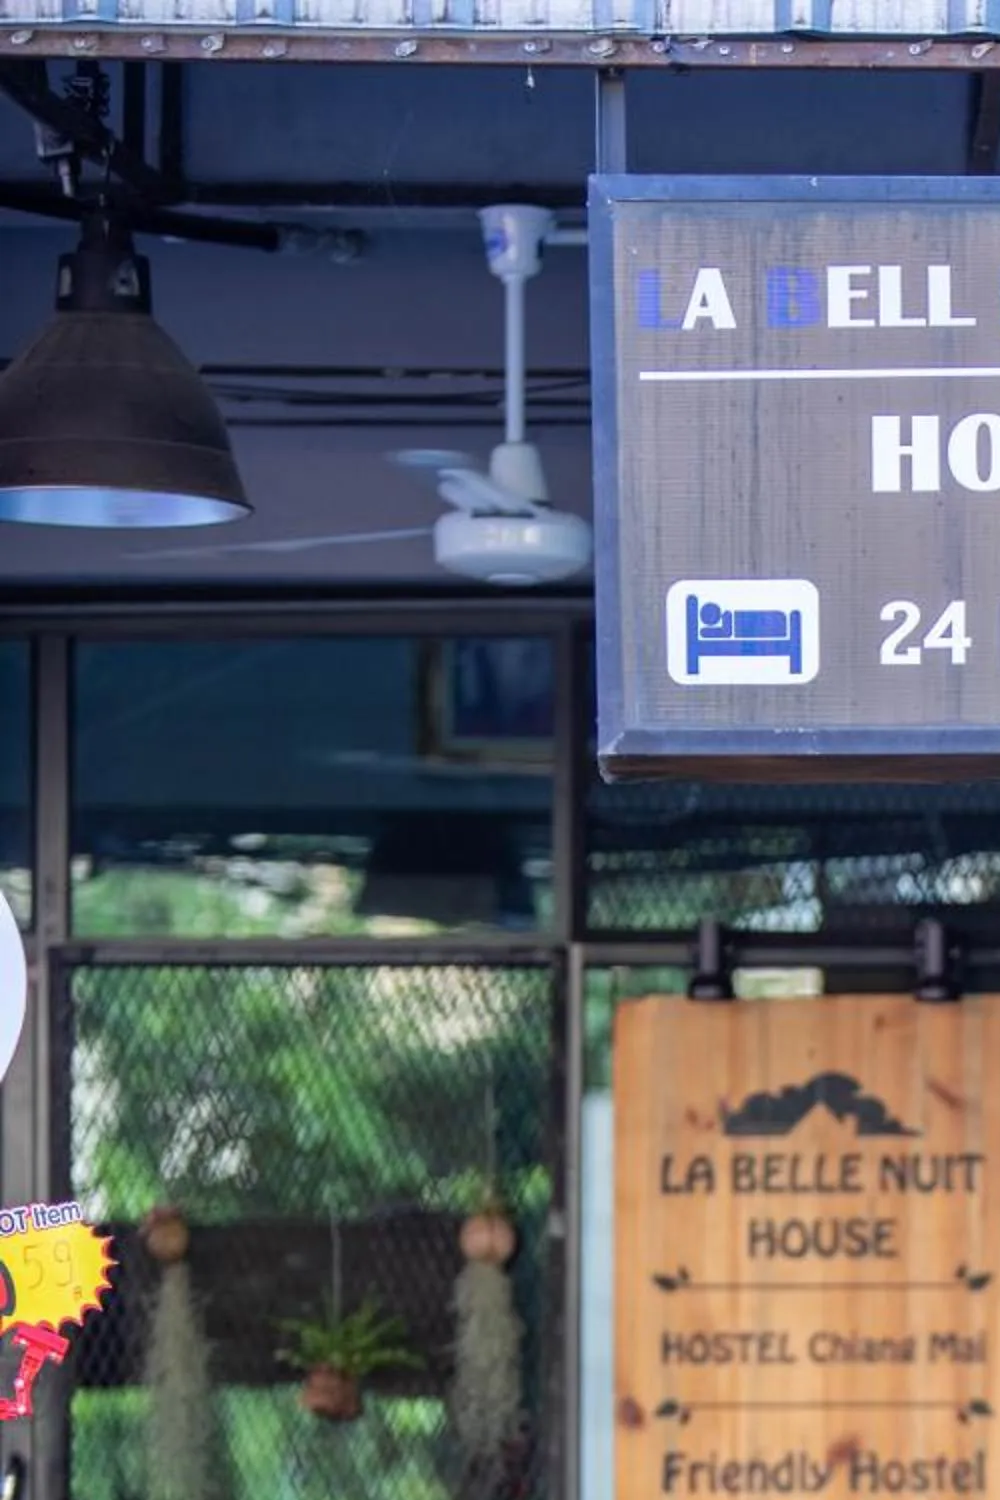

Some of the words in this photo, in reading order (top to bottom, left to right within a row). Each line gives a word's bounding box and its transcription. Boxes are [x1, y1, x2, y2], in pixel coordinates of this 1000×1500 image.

[636, 267, 737, 330] LA
[765, 265, 976, 329] BELL
[879, 600, 972, 667] 24
[660, 1154, 716, 1194] LA
[730, 1154, 863, 1194] BELLE
[879, 1153, 986, 1194] NUIT
[33, 1203, 80, 1228] Item
[747, 1218, 898, 1259] HOUSE
[23, 1240, 73, 1290] 59
[661, 1331, 795, 1365] HOSTEL
[927, 1331, 987, 1363] Mai
[661, 1451, 833, 1494] Friendly
[848, 1450, 986, 1493] Hostel
